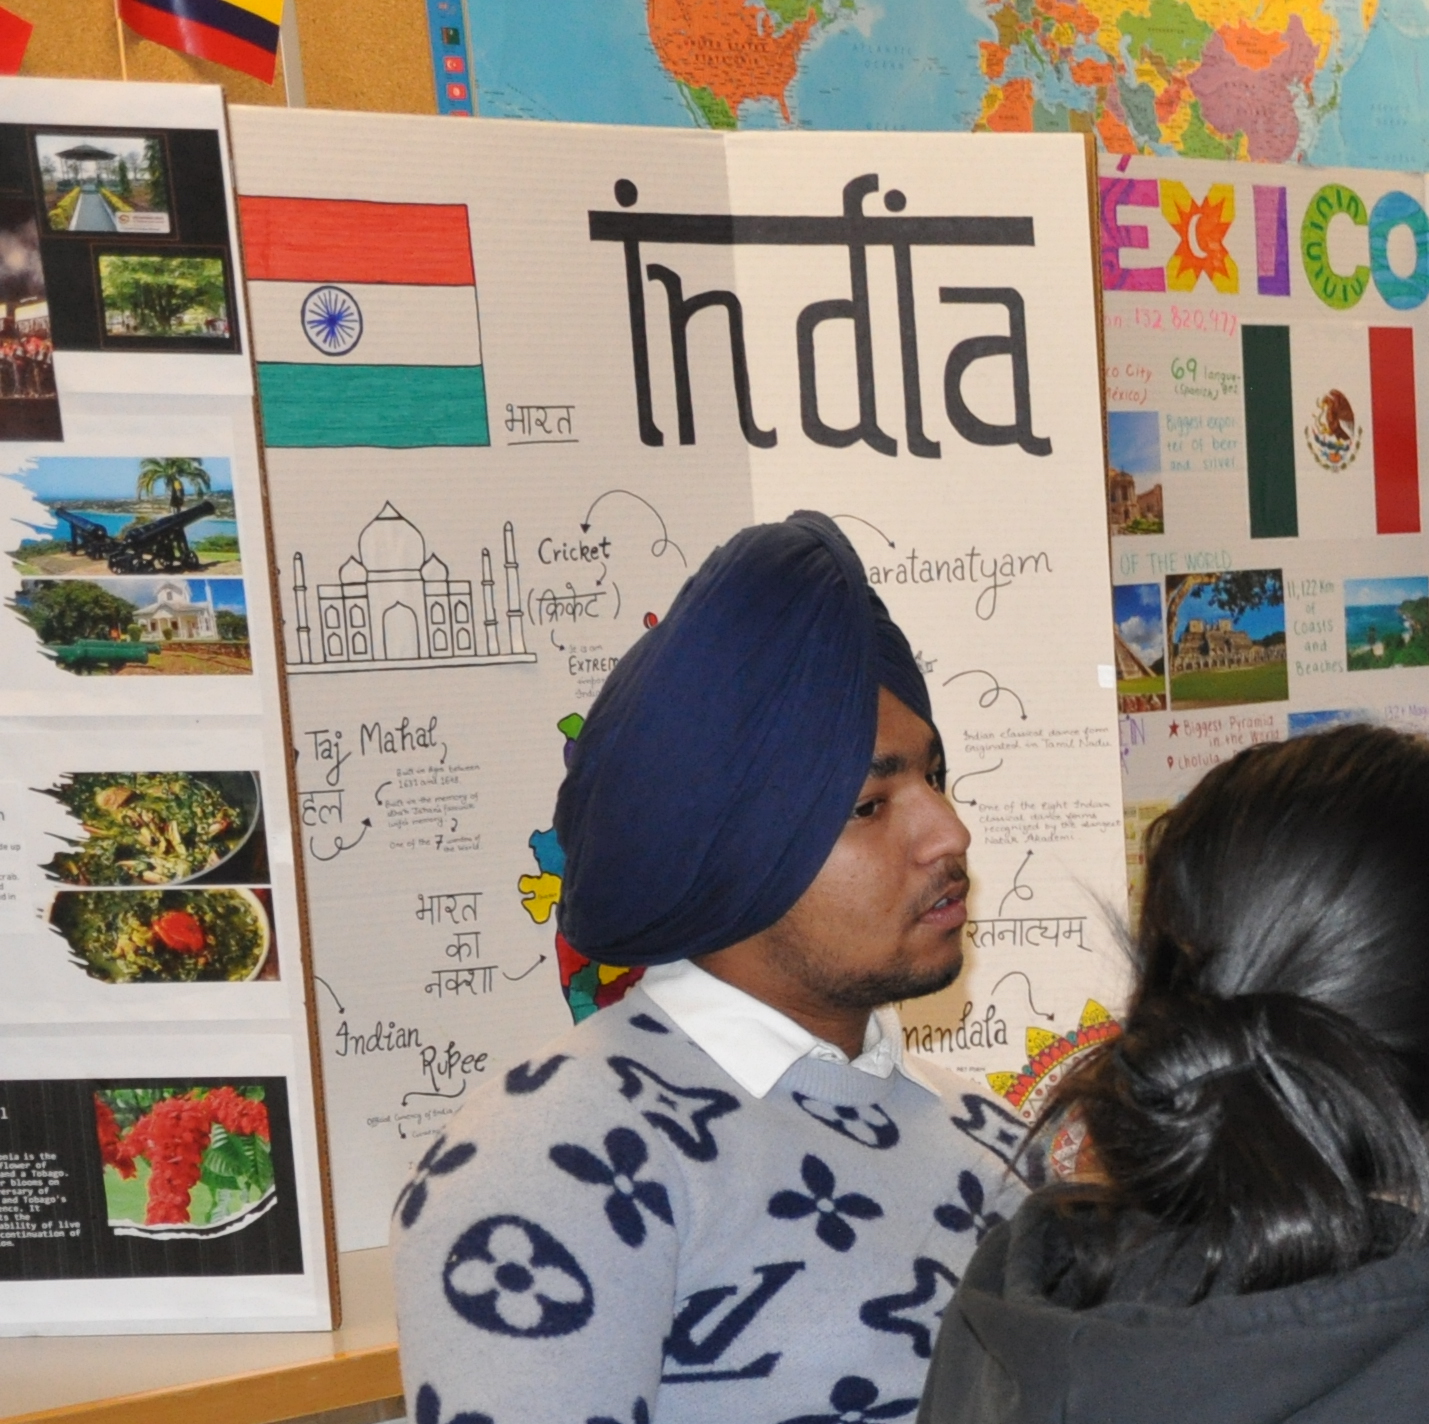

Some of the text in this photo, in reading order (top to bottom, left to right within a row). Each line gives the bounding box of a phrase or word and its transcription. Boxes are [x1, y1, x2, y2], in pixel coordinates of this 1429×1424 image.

[1125, 364, 1153, 384] City
[1171, 357, 1198, 382] 69
[505, 403, 576, 436] भारत
[538, 536, 612, 564] Cricket
[1145, 553, 1178, 574] THE
[1184, 551, 1232, 572] WORLD
[1304, 639, 1328, 653] and
[1295, 659, 1344, 676] Beaches
[963, 726, 1109, 741] Indian classical dance form
[1182, 714, 1274, 741] Biggest Pyramid
[1041, 738, 1075, 749] Tamil
[1078, 737, 1112, 748] Nadu
[1208, 735, 1220, 748] in
[1224, 733, 1244, 746] the
[304, 716, 438, 786] Taj Mahal
[434, 794, 467, 805] memory
[1004, 801, 1015, 814] of
[1020, 801, 1036, 811] the
[1073, 800, 1111, 809] Indian
[979, 815, 1024, 824] classical
[984, 822, 1040, 838] recognized
[1044, 822, 1057, 833] by
[1060, 821, 1076, 829] the
[389, 841, 403, 849] One
[406, 838, 415, 850] of
[418, 838, 431, 846] the
[434, 834, 444, 850] 7
[984, 833, 1075, 845] Natak Akademi
[10, 843, 21, 852] up
[8, 892, 16, 900] in
[415, 891, 483, 926] भारत
[445, 931, 481, 963] का
[335, 1020, 423, 1057] Indian
[420, 1041, 488, 1092] Rupee
[23, 1152, 57, 1161] is the
[35, 1161, 47, 1170] of
[31, 1169, 69, 1179] Tobago.
[10, 1178, 44, 1187] blooms
[38, 1186, 50, 1195] of
[1, 1194, 67, 1206] and Tobago's
[29, 1204, 41, 1213] It
[14, 1213, 31, 1221] the
[41, 1220, 53, 1229] of
[58, 1220, 81, 1229] live
[0, 1229, 81, 1239] continuation of
